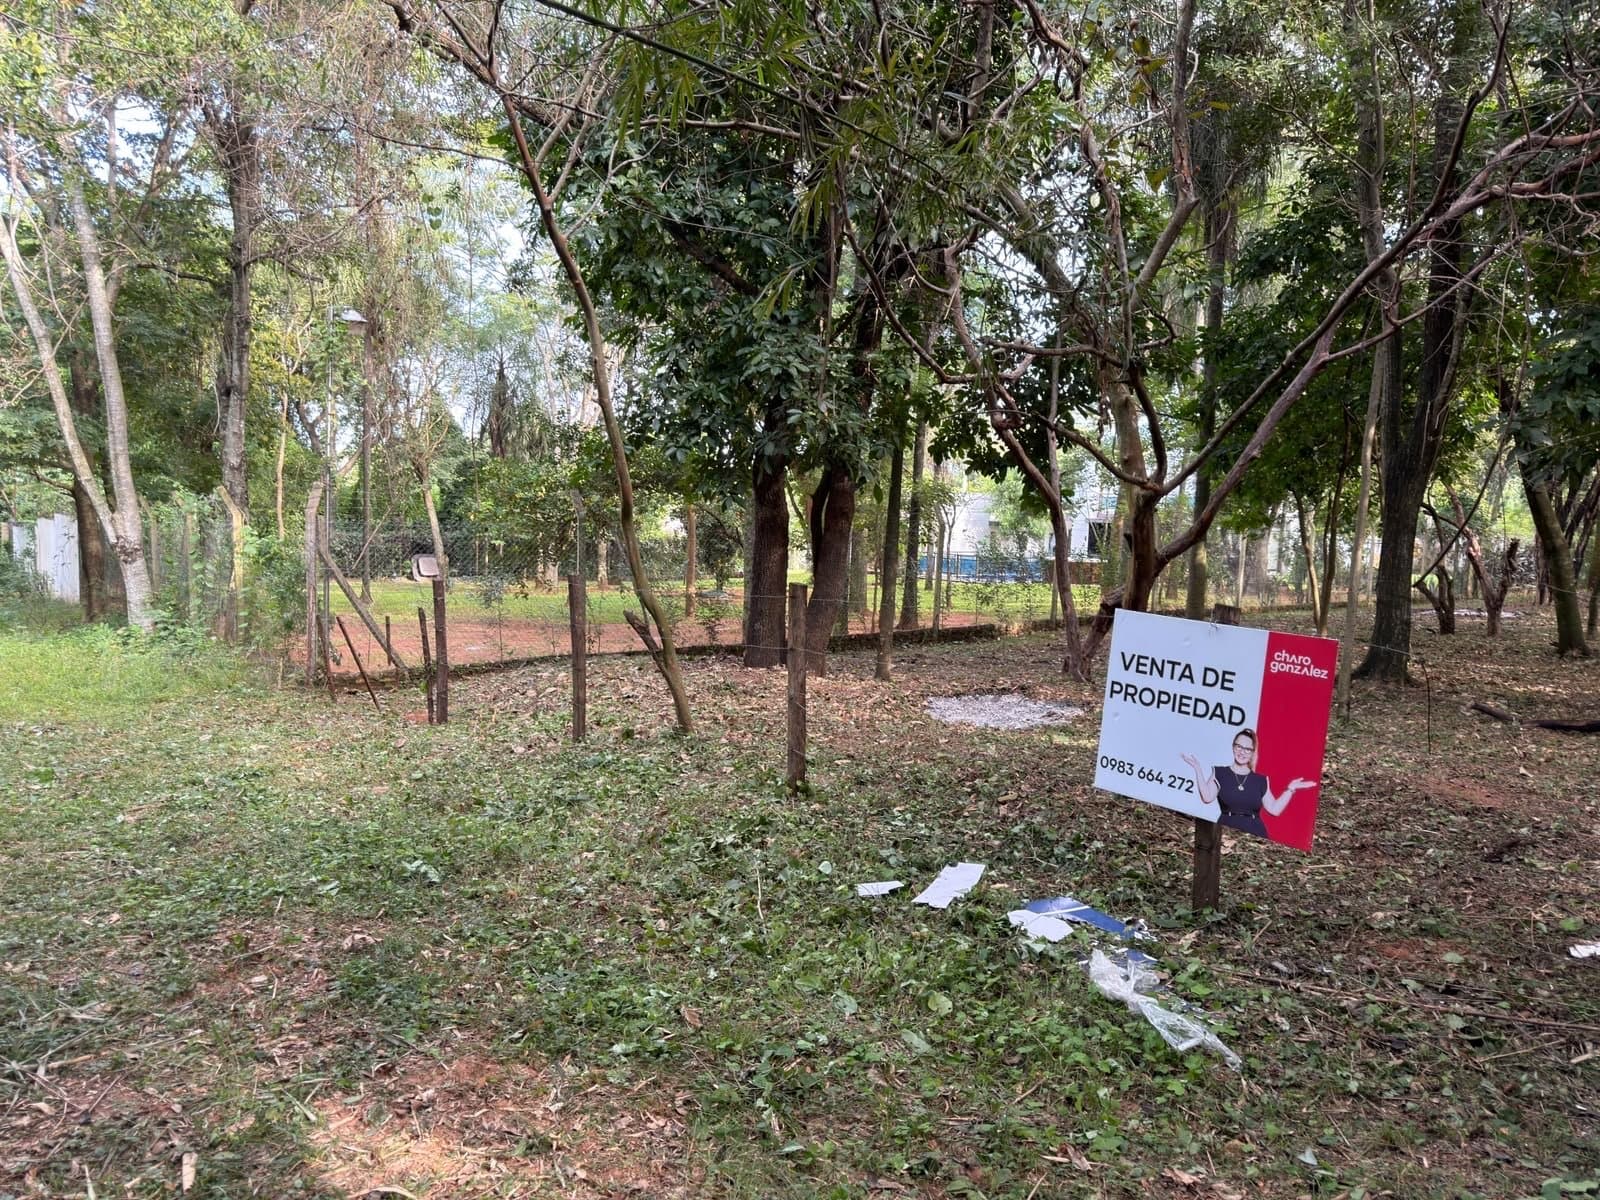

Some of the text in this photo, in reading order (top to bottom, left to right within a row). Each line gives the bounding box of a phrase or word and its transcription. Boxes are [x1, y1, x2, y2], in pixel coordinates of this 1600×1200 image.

[1120, 651, 1236, 692] VENTA DE
[1109, 680, 1246, 727] PROPIEDAD
[1100, 755, 1194, 794] 0983 664 272
